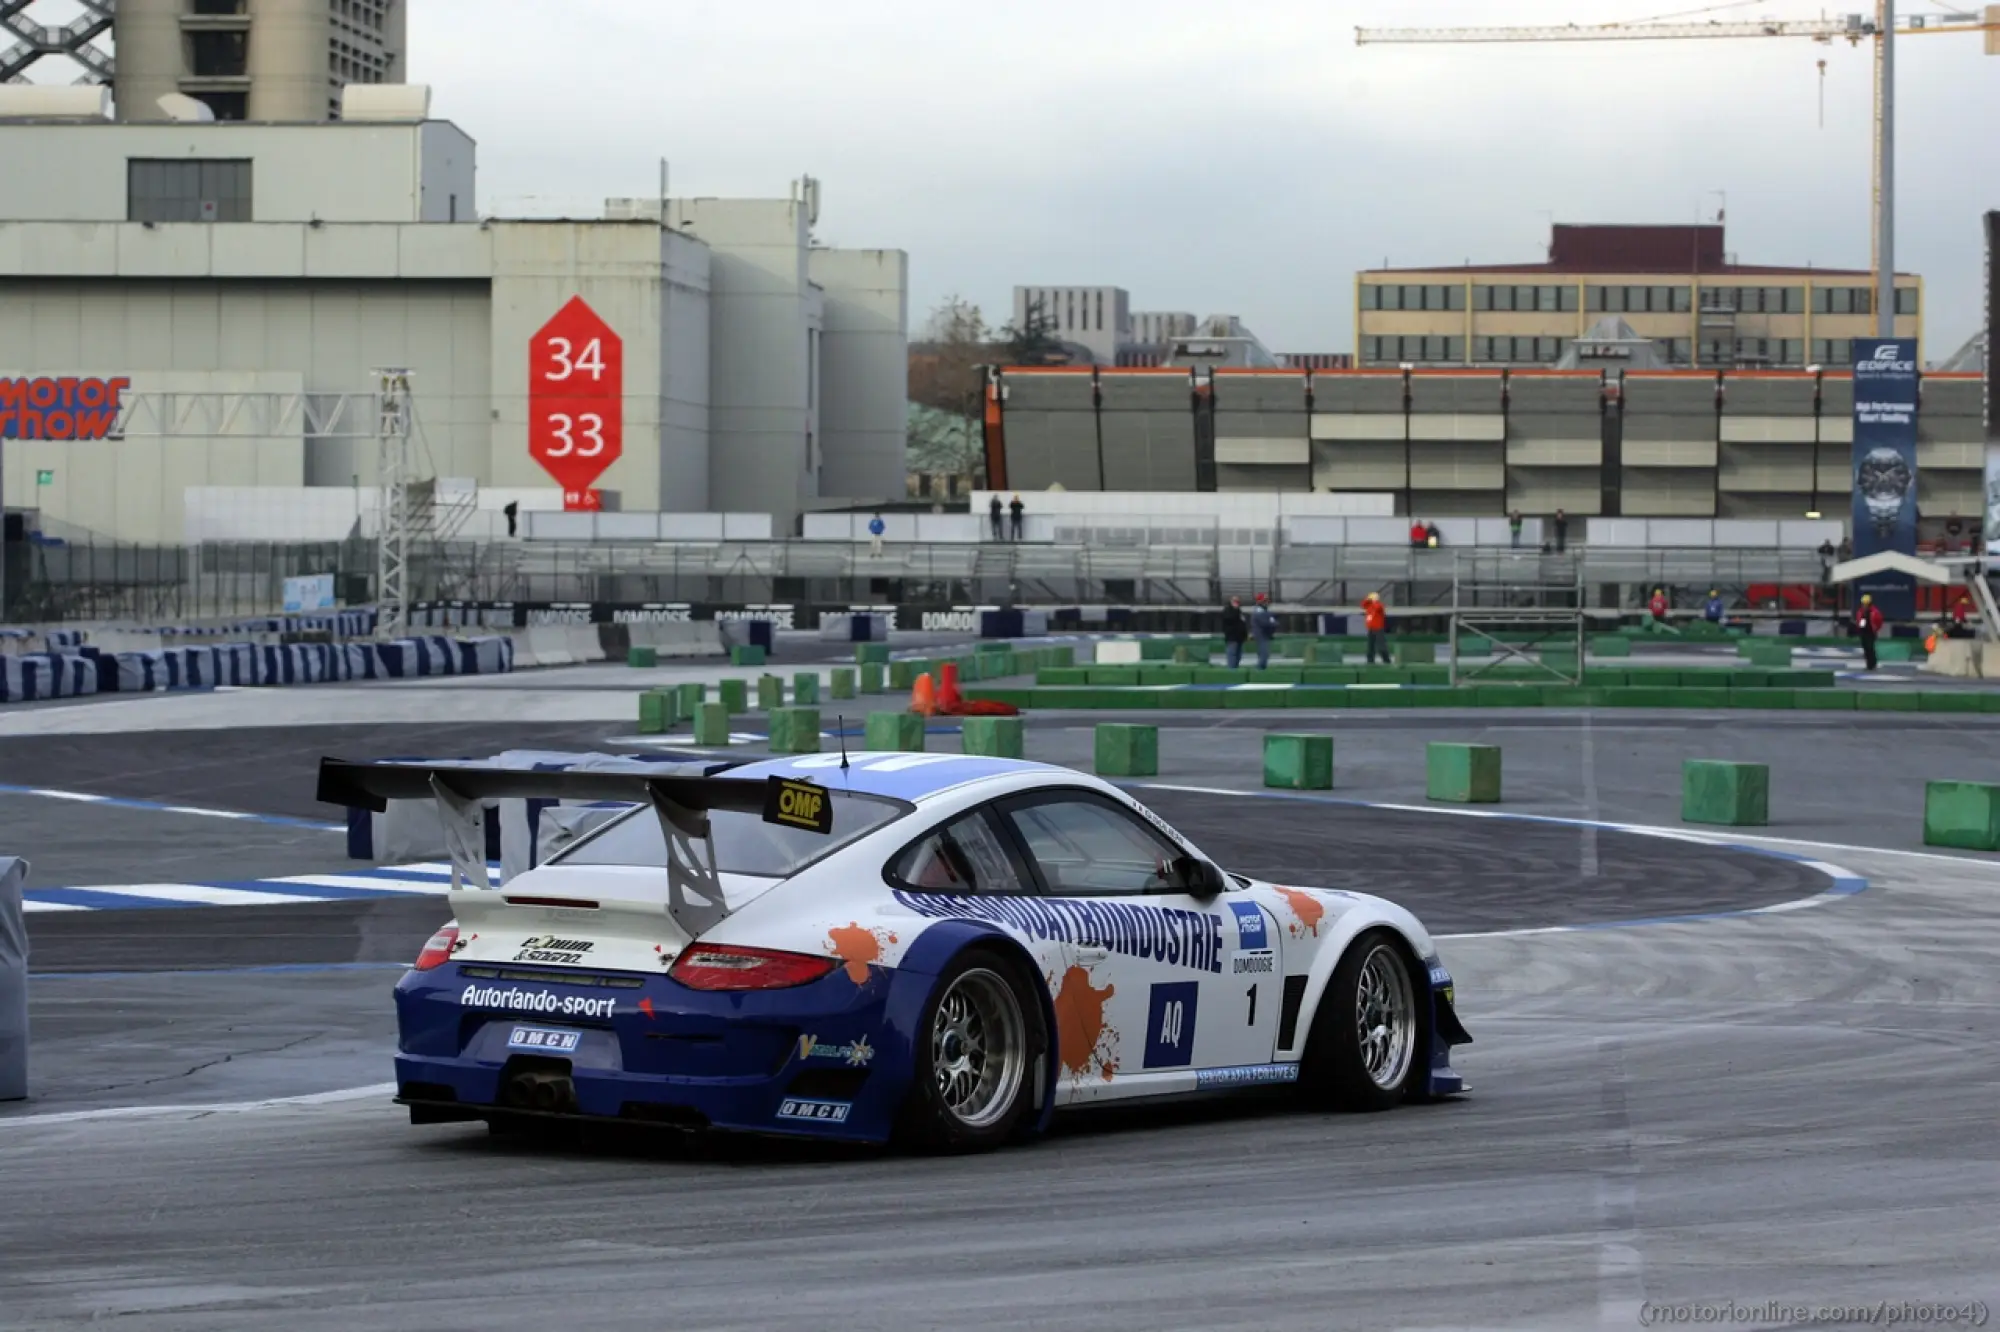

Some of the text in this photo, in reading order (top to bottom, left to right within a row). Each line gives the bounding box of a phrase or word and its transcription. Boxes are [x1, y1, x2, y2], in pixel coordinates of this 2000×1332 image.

[545, 337, 606, 380] 34
[1856, 360, 1915, 371] EDIFICE
[546, 413, 604, 456] 33
[780, 789, 823, 819] OMP
[461, 984, 616, 1018] Autorlando-sport
[1247, 983, 1257, 1026] 1
[513, 1031, 577, 1048] OMCN
[1160, 1000, 1183, 1048] AQ
[782, 1102, 846, 1118] OMCN
